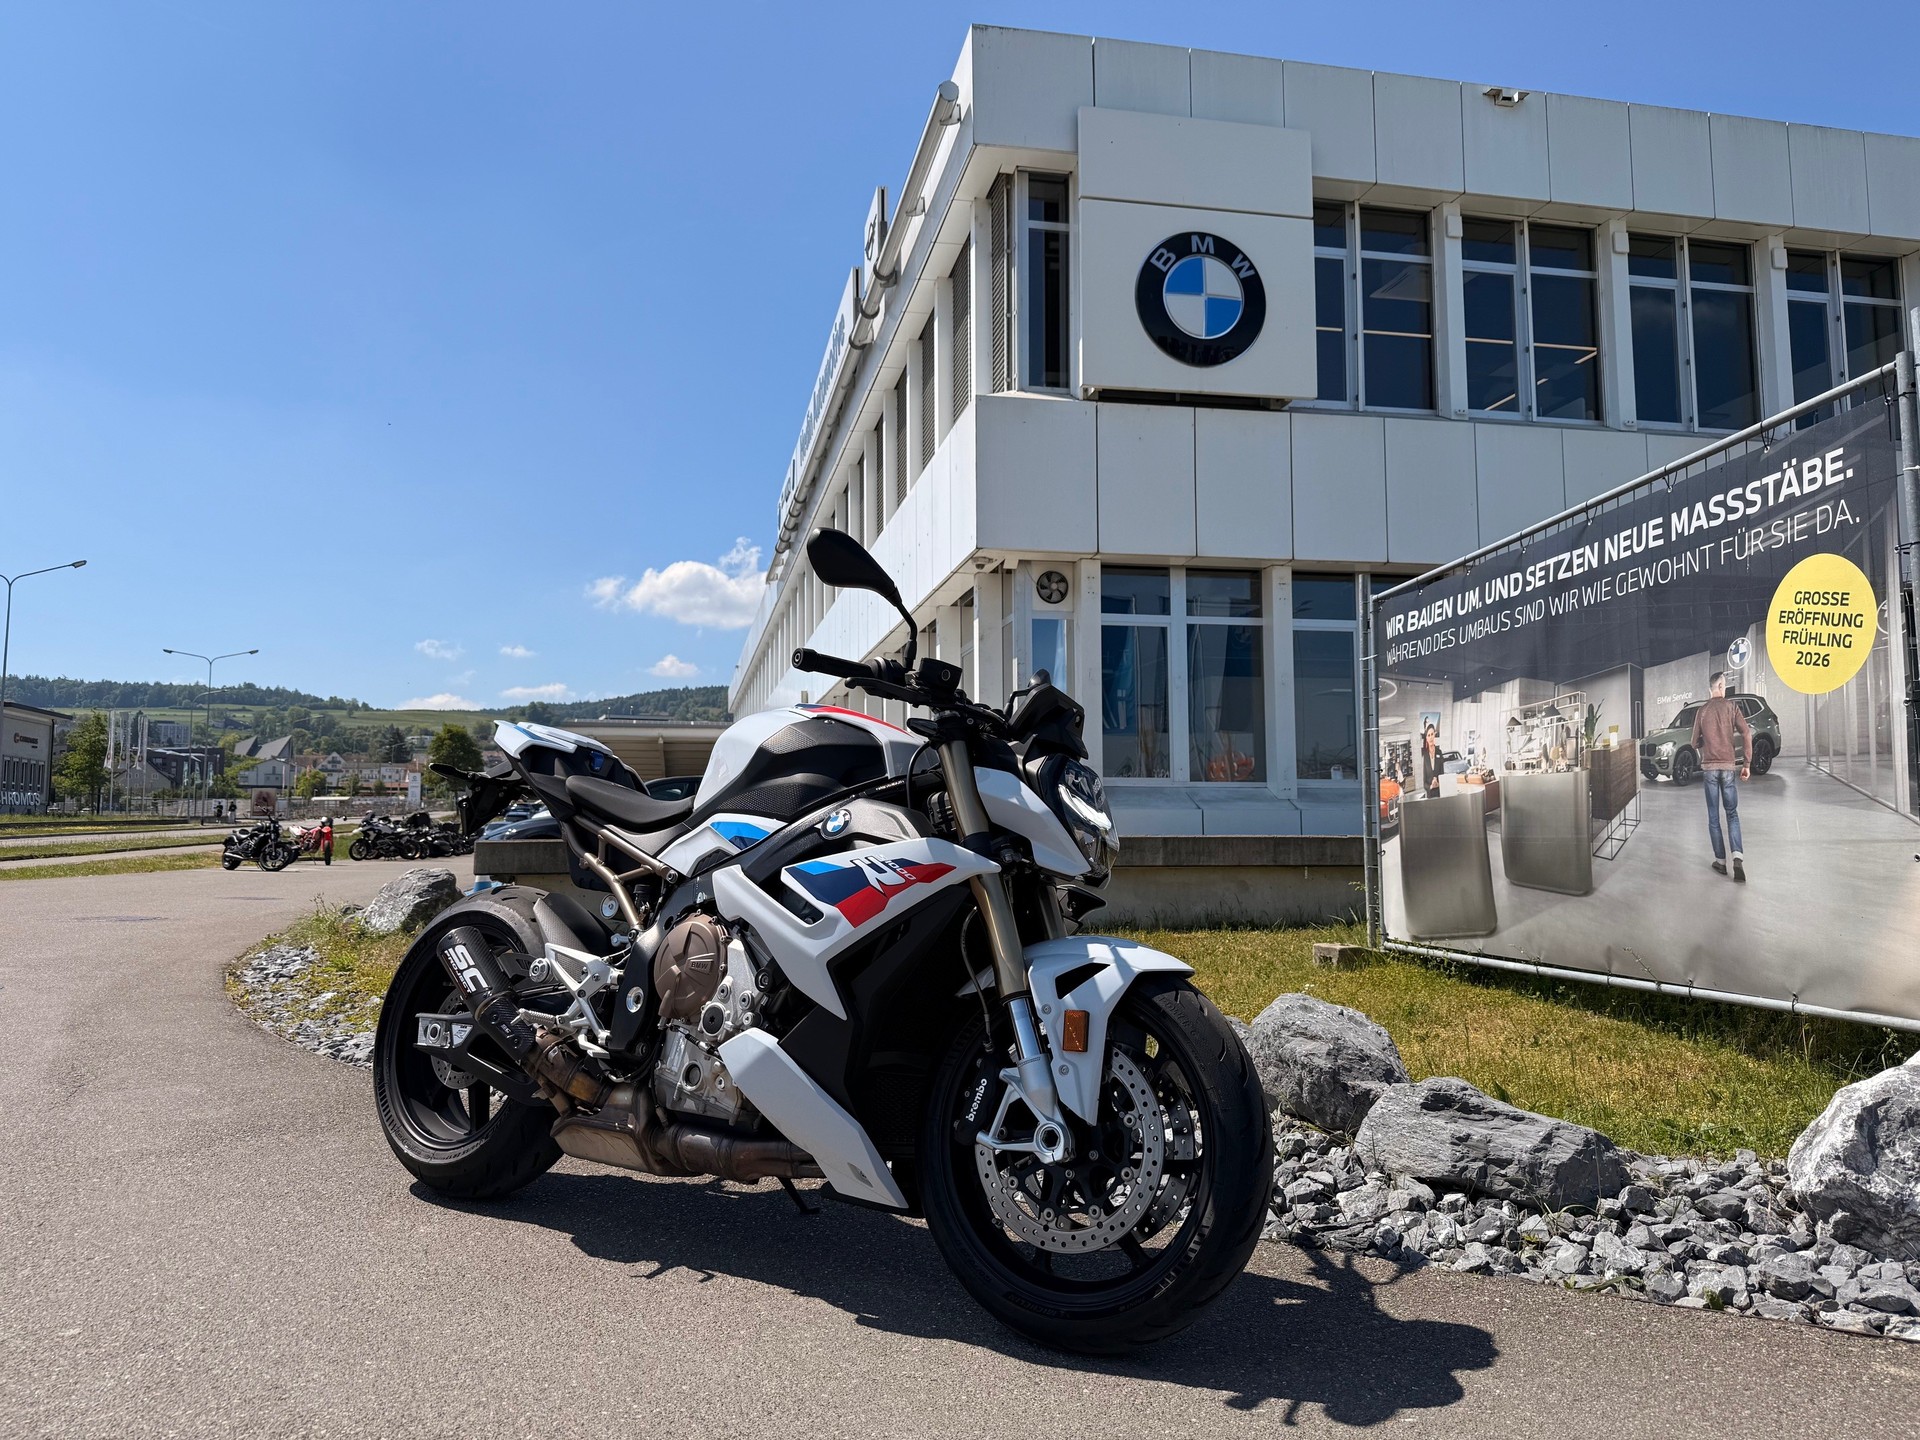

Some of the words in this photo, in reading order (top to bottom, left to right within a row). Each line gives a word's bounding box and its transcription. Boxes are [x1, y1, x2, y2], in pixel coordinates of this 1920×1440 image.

[1150, 234, 1255, 279] BMW
[1386, 614, 1404, 639] WIR
[1407, 596, 1453, 632] BAUEN
[1457, 587, 1482, 615] UM.
[1485, 572, 1523, 604] UND
[1526, 542, 1598, 591] SETZEN
[1604, 517, 1664, 564] NEUE
[1671, 447, 1853, 541] MASSSTÄBE.
[1387, 637, 1431, 666] WÄHREND
[1433, 628, 1455, 651] DES
[1459, 610, 1510, 645] UMBAUS
[1514, 599, 1544, 628] SIND
[1549, 589, 1579, 616] WIR
[1582, 577, 1611, 607] WIE
[1616, 543, 1714, 596] GEWOHNT
[1721, 527, 1764, 565] FÜR
[1771, 512, 1808, 548] SIE
[1816, 499, 1860, 534] DA.
[1794, 591, 1850, 606] GROSSE
[1779, 608, 1863, 628] ERÖFFNUNG
[1783, 628, 1852, 648] FRÜHLING
[1796, 651, 1830, 667] 2026
[1657, 696, 1672, 705] BMW
[1672, 691, 1693, 702] Service
[0, 791, 41, 806] HROMOS
[448, 944, 489, 993] SC
[691, 962, 709, 970] BMW
[966, 1078, 987, 1122] brembo
